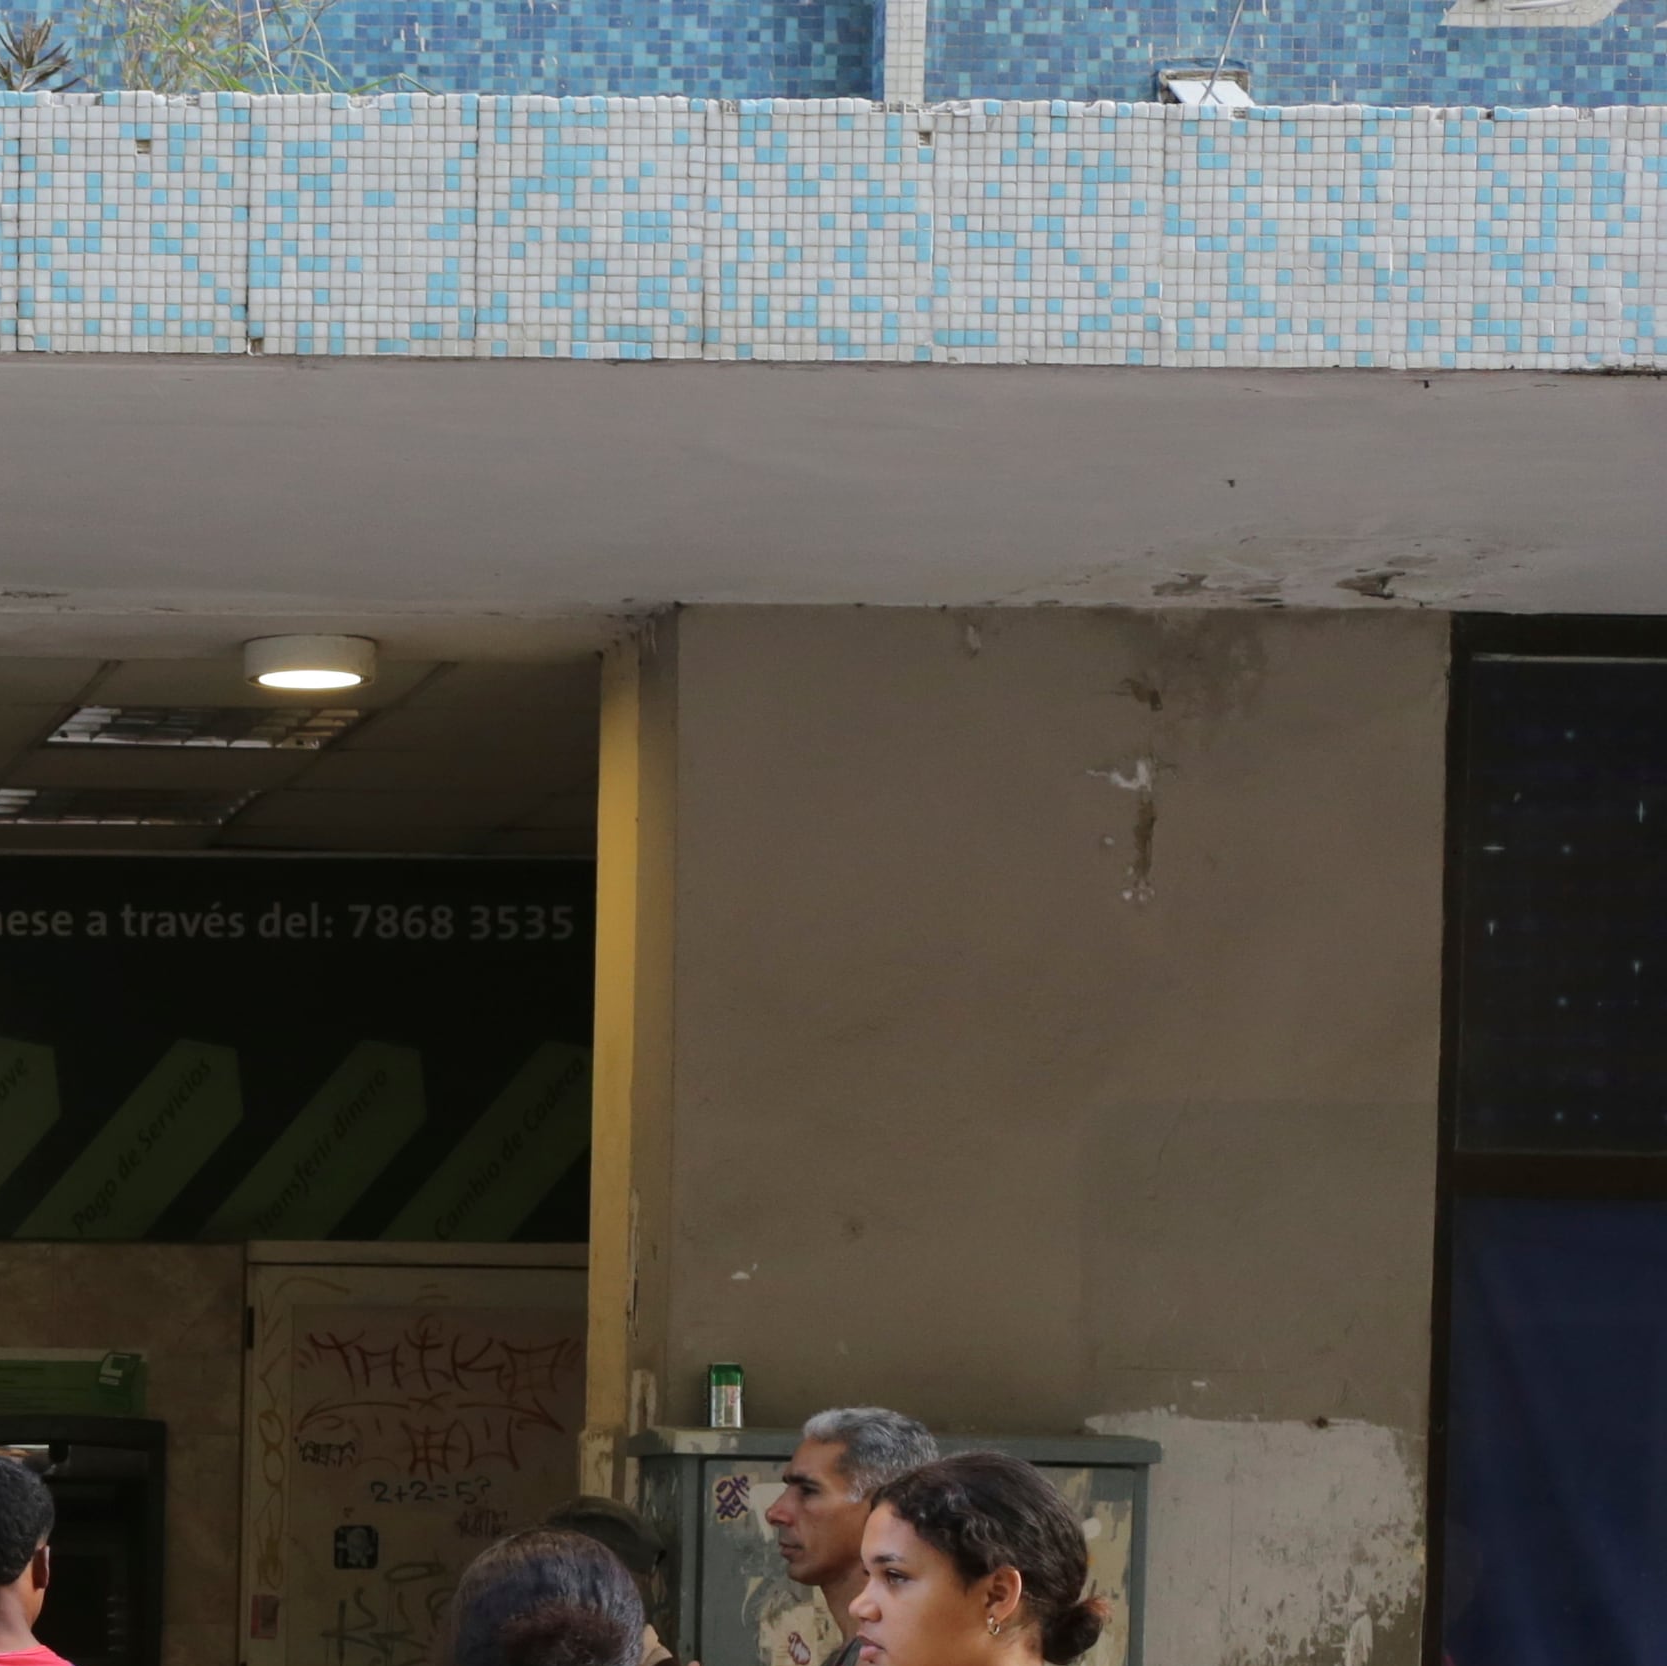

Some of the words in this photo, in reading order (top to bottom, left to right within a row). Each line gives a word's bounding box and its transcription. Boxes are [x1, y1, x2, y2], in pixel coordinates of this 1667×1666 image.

[85, 909, 109, 938] a
[121, 901, 246, 939] través
[258, 901, 334, 939] del:
[348, 904, 455, 941] 7868
[469, 904, 575, 941] 3535
[71, 1180, 119, 1236] Pago
[116, 1147, 142, 1184] de
[137, 1055, 213, 1153] Servicios
[434, 1160, 501, 1241] Cambio
[501, 1132, 524, 1163] de
